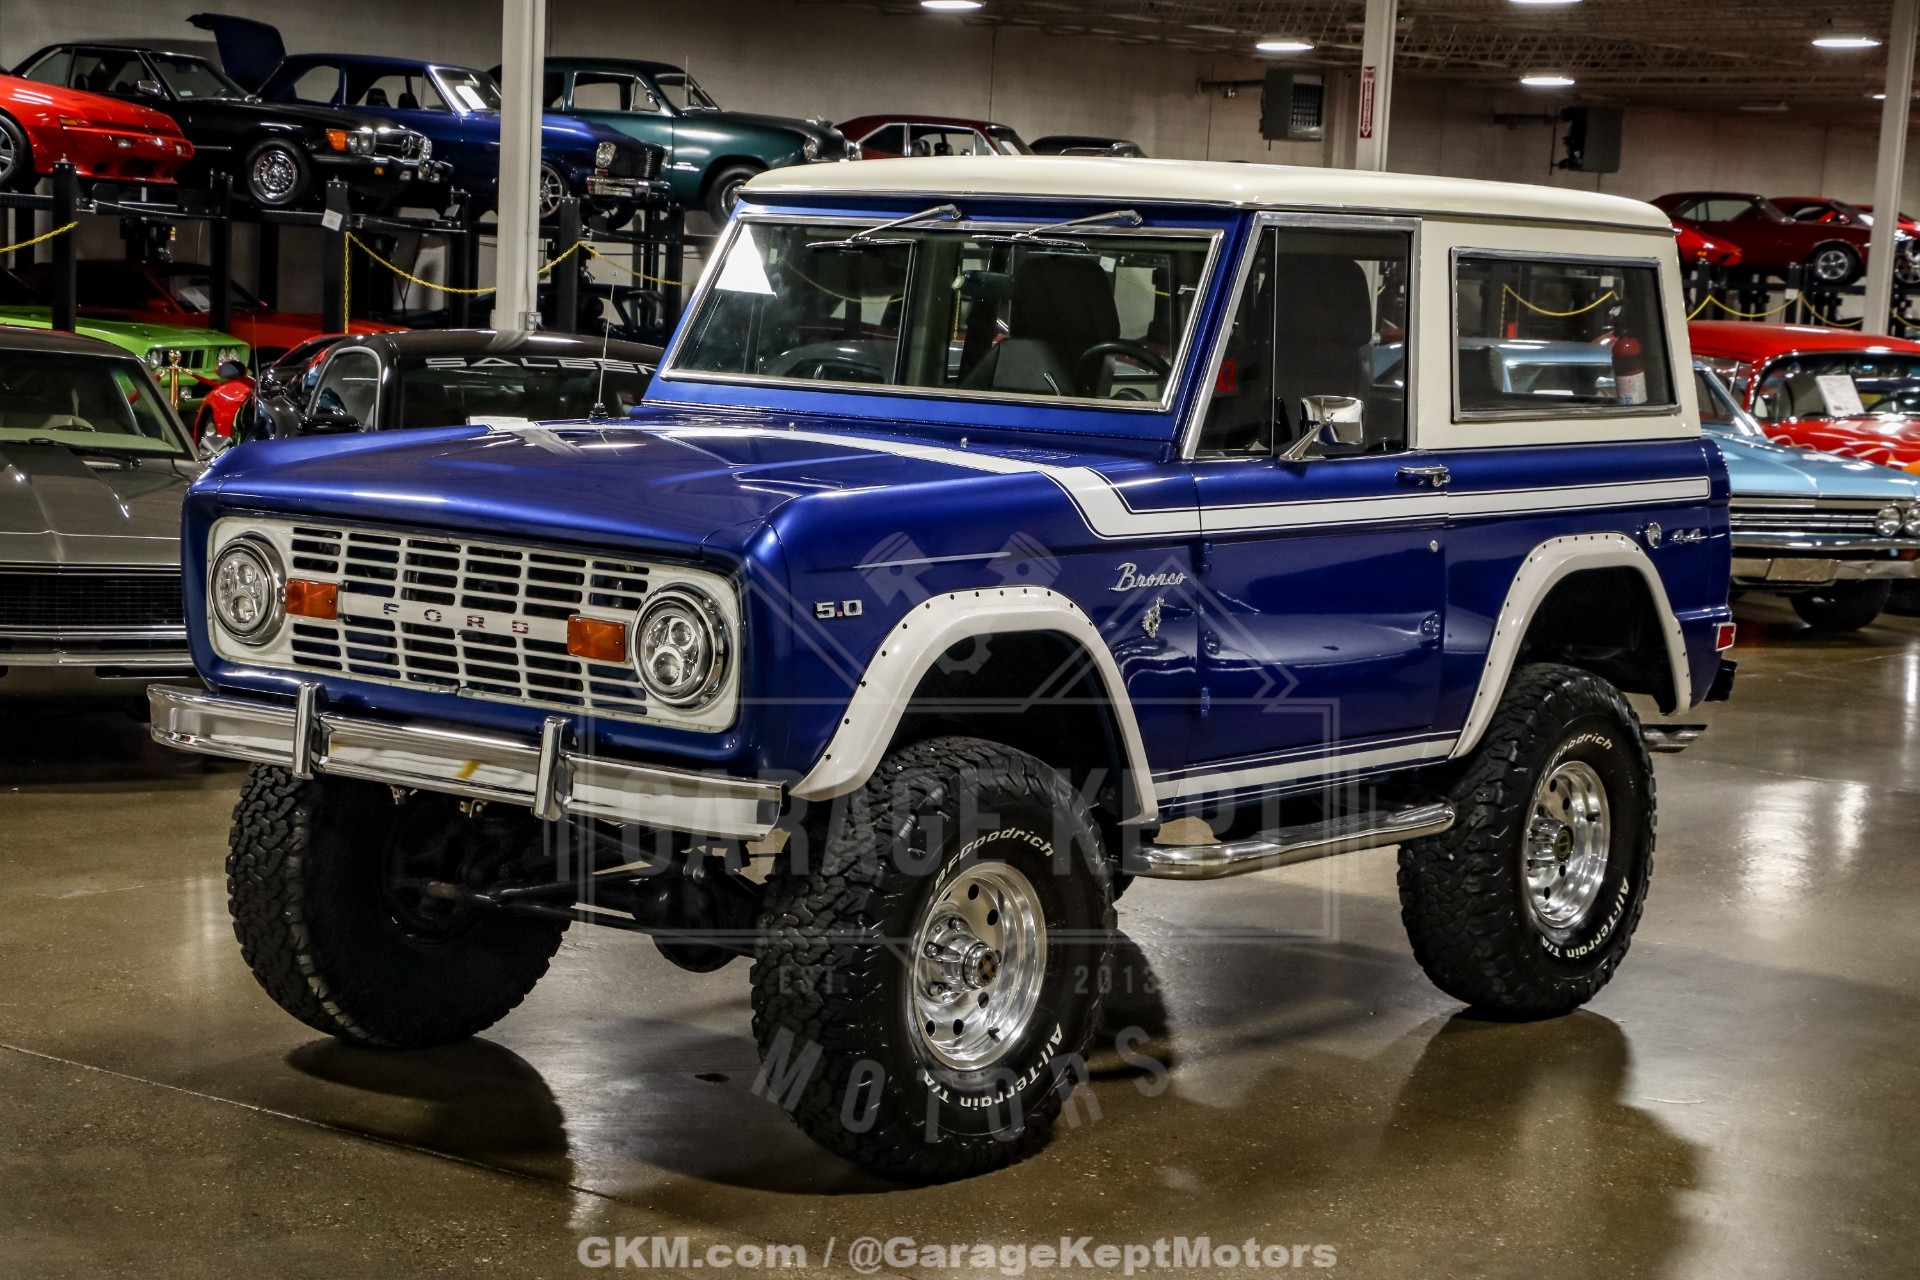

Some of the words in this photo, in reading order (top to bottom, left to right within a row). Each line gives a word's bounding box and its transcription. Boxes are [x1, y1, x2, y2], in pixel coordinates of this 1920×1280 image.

[814, 599, 863, 619] 5.0
[1108, 562, 1187, 592] Bronco
[383, 602, 529, 634] FORD
[1536, 732, 1613, 797] Goodrich
[934, 827, 1055, 892] BFGoodrich
[1566, 876, 1630, 959] All-Terrain
[960, 1022, 1064, 1111] All-Terrain
